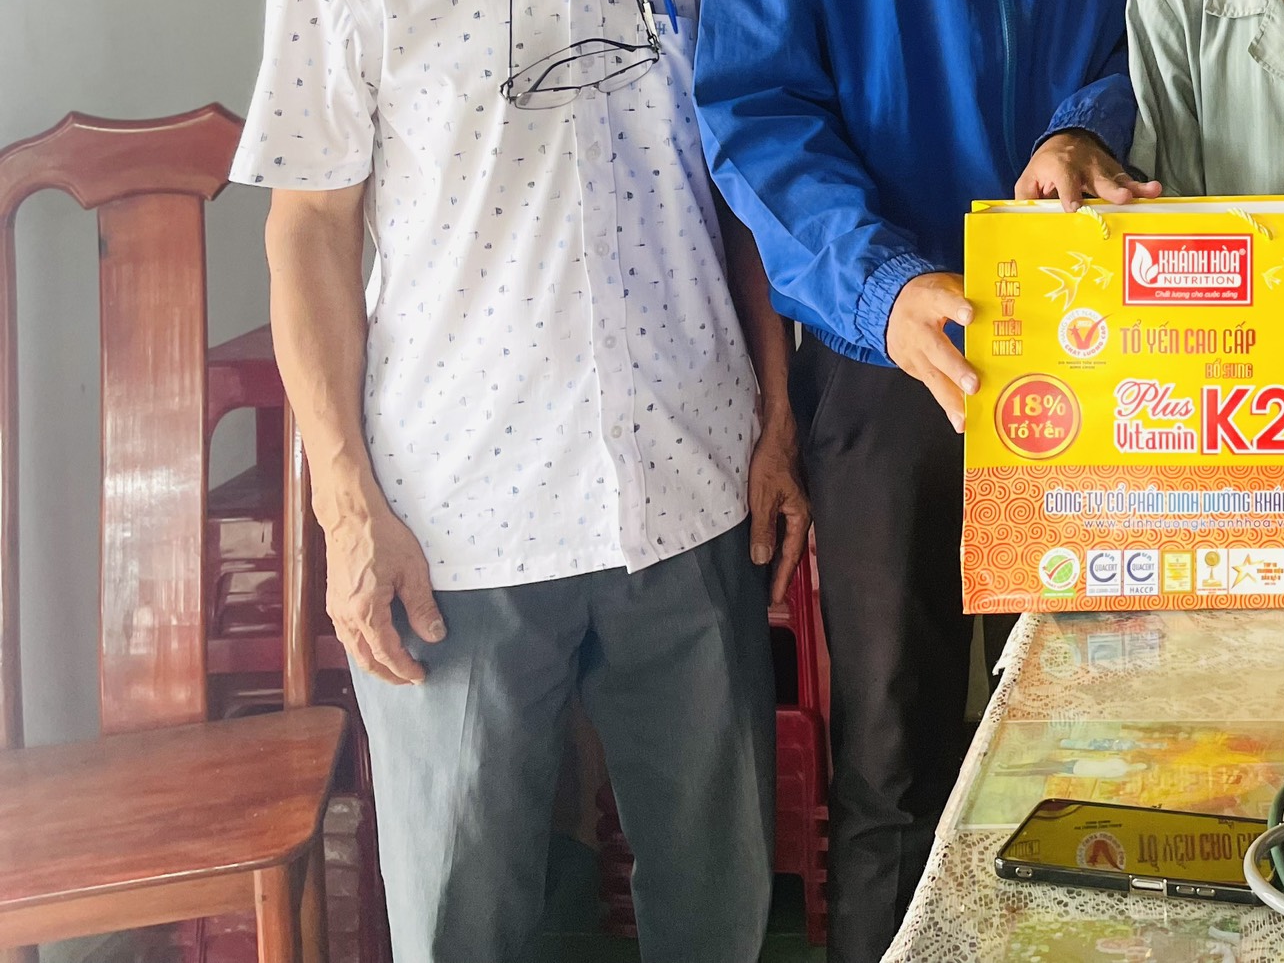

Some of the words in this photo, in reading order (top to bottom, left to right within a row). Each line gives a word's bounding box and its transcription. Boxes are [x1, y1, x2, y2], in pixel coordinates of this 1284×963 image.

[997, 259, 1018, 278] QUÀ
[1158, 245, 1208, 273] KHÁNH
[1210, 245, 1240, 273] HÒA
[995, 279, 1020, 299] TẶNG
[1163, 276, 1235, 285] NUTRITION
[993, 318, 1022, 336] THIÊN
[1120, 319, 1142, 354] TỔ
[1146, 321, 1179, 354] YẾN
[1184, 328, 1217, 354] CAO
[1223, 321, 1256, 354] CẤP
[992, 338, 1022, 356] NHIÊN
[1222, 363, 1253, 378] SUNG
[1011, 393, 1066, 416] 18%
[1116, 381, 1193, 417] Plus
[1008, 420, 1029, 439] Tổ
[1031, 420, 1065, 439] Yến
[1117, 423, 1195, 450] Vitamin
[1045, 488, 1082, 513] CÔNG
[1086, 492, 1103, 513] TY
[1106, 485, 1125, 513] CỔ
[1128, 486, 1164, 513] PHẦN
[1168, 492, 1199, 513] DINH
[1203, 489, 1251, 513] DƯỠNG
[1132, 563, 1155, 571] QUACERT
